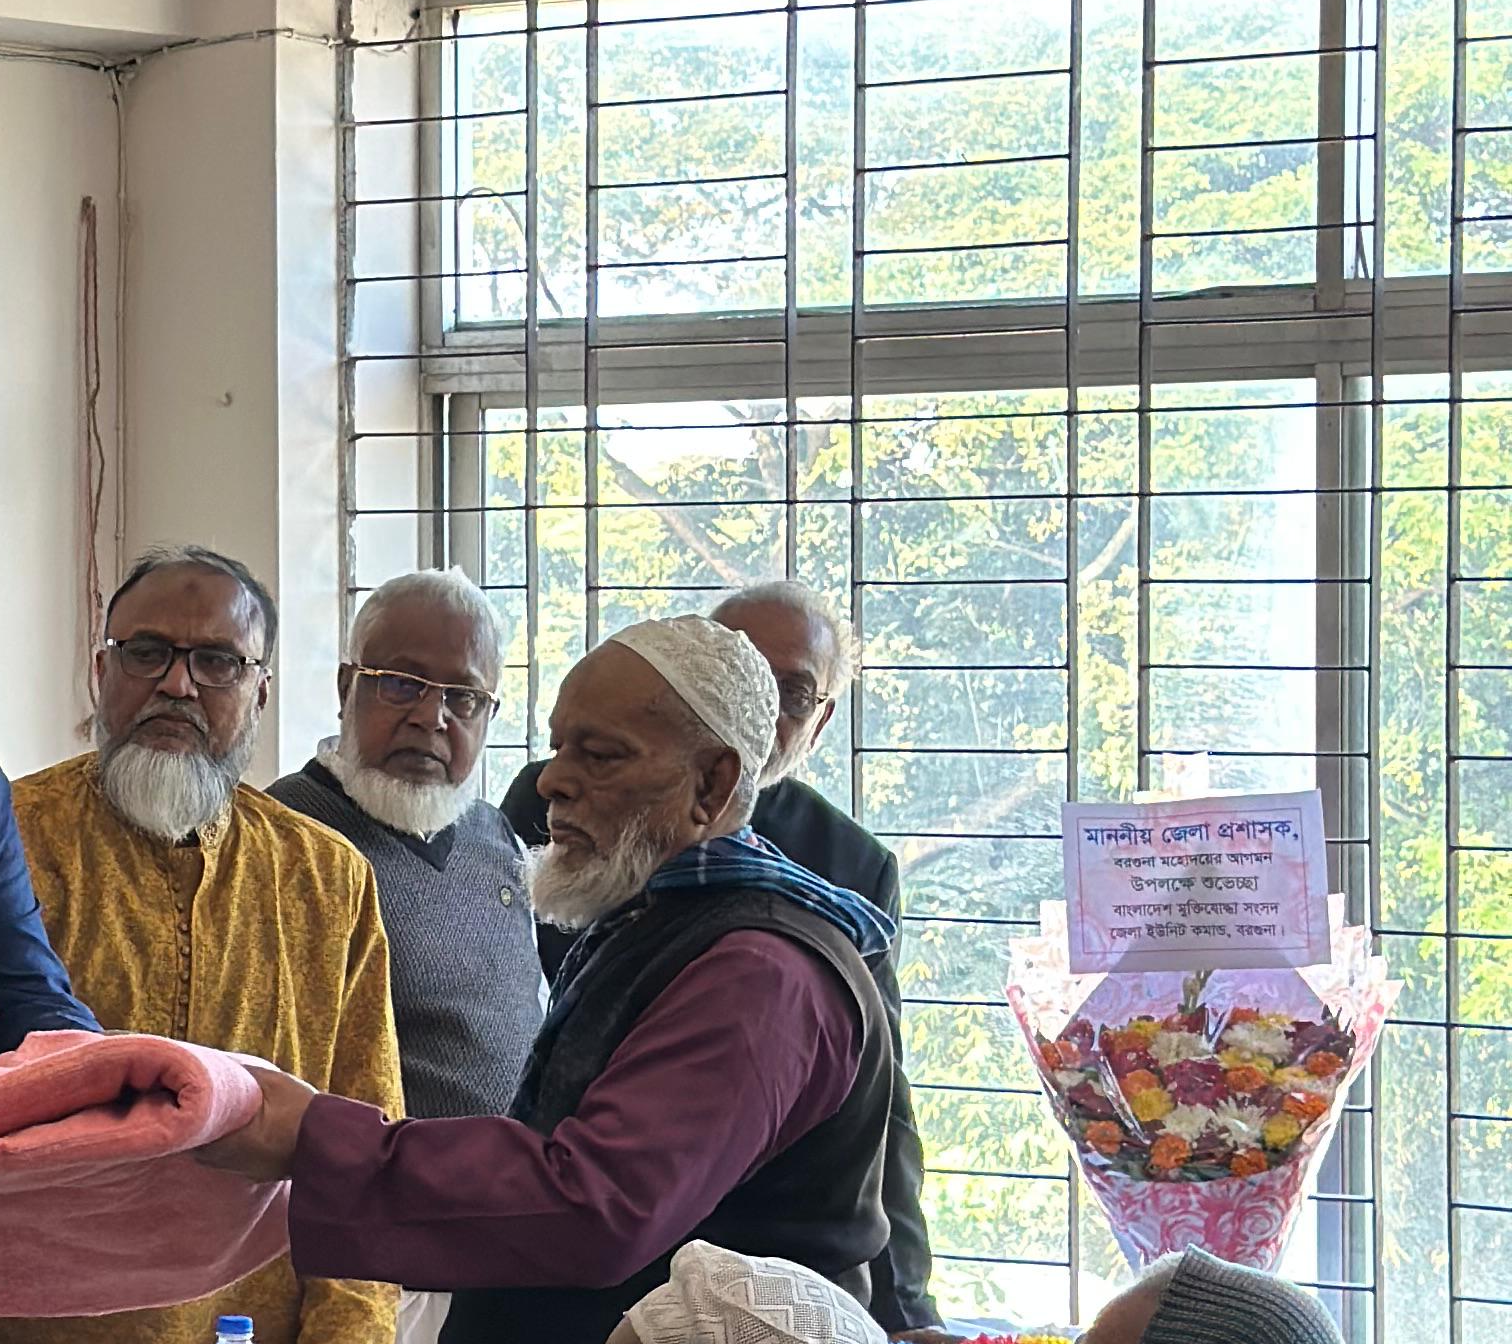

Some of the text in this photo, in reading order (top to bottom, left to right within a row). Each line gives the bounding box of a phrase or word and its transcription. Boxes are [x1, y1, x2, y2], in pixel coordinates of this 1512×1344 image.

[1083, 819, 1299, 846] মাননীয় জেলা প্রশাসক,
[1113, 855, 1157, 869] বরগুনা
[1226, 851, 1273, 866] আগমন
[1201, 875, 1259, 892] শুভেচ্ছা
[1111, 898, 1281, 918] বাংলাদেশ মুক্তিযোদ্ধা সংসদ
[1108, 925, 1143, 940] জেলা
